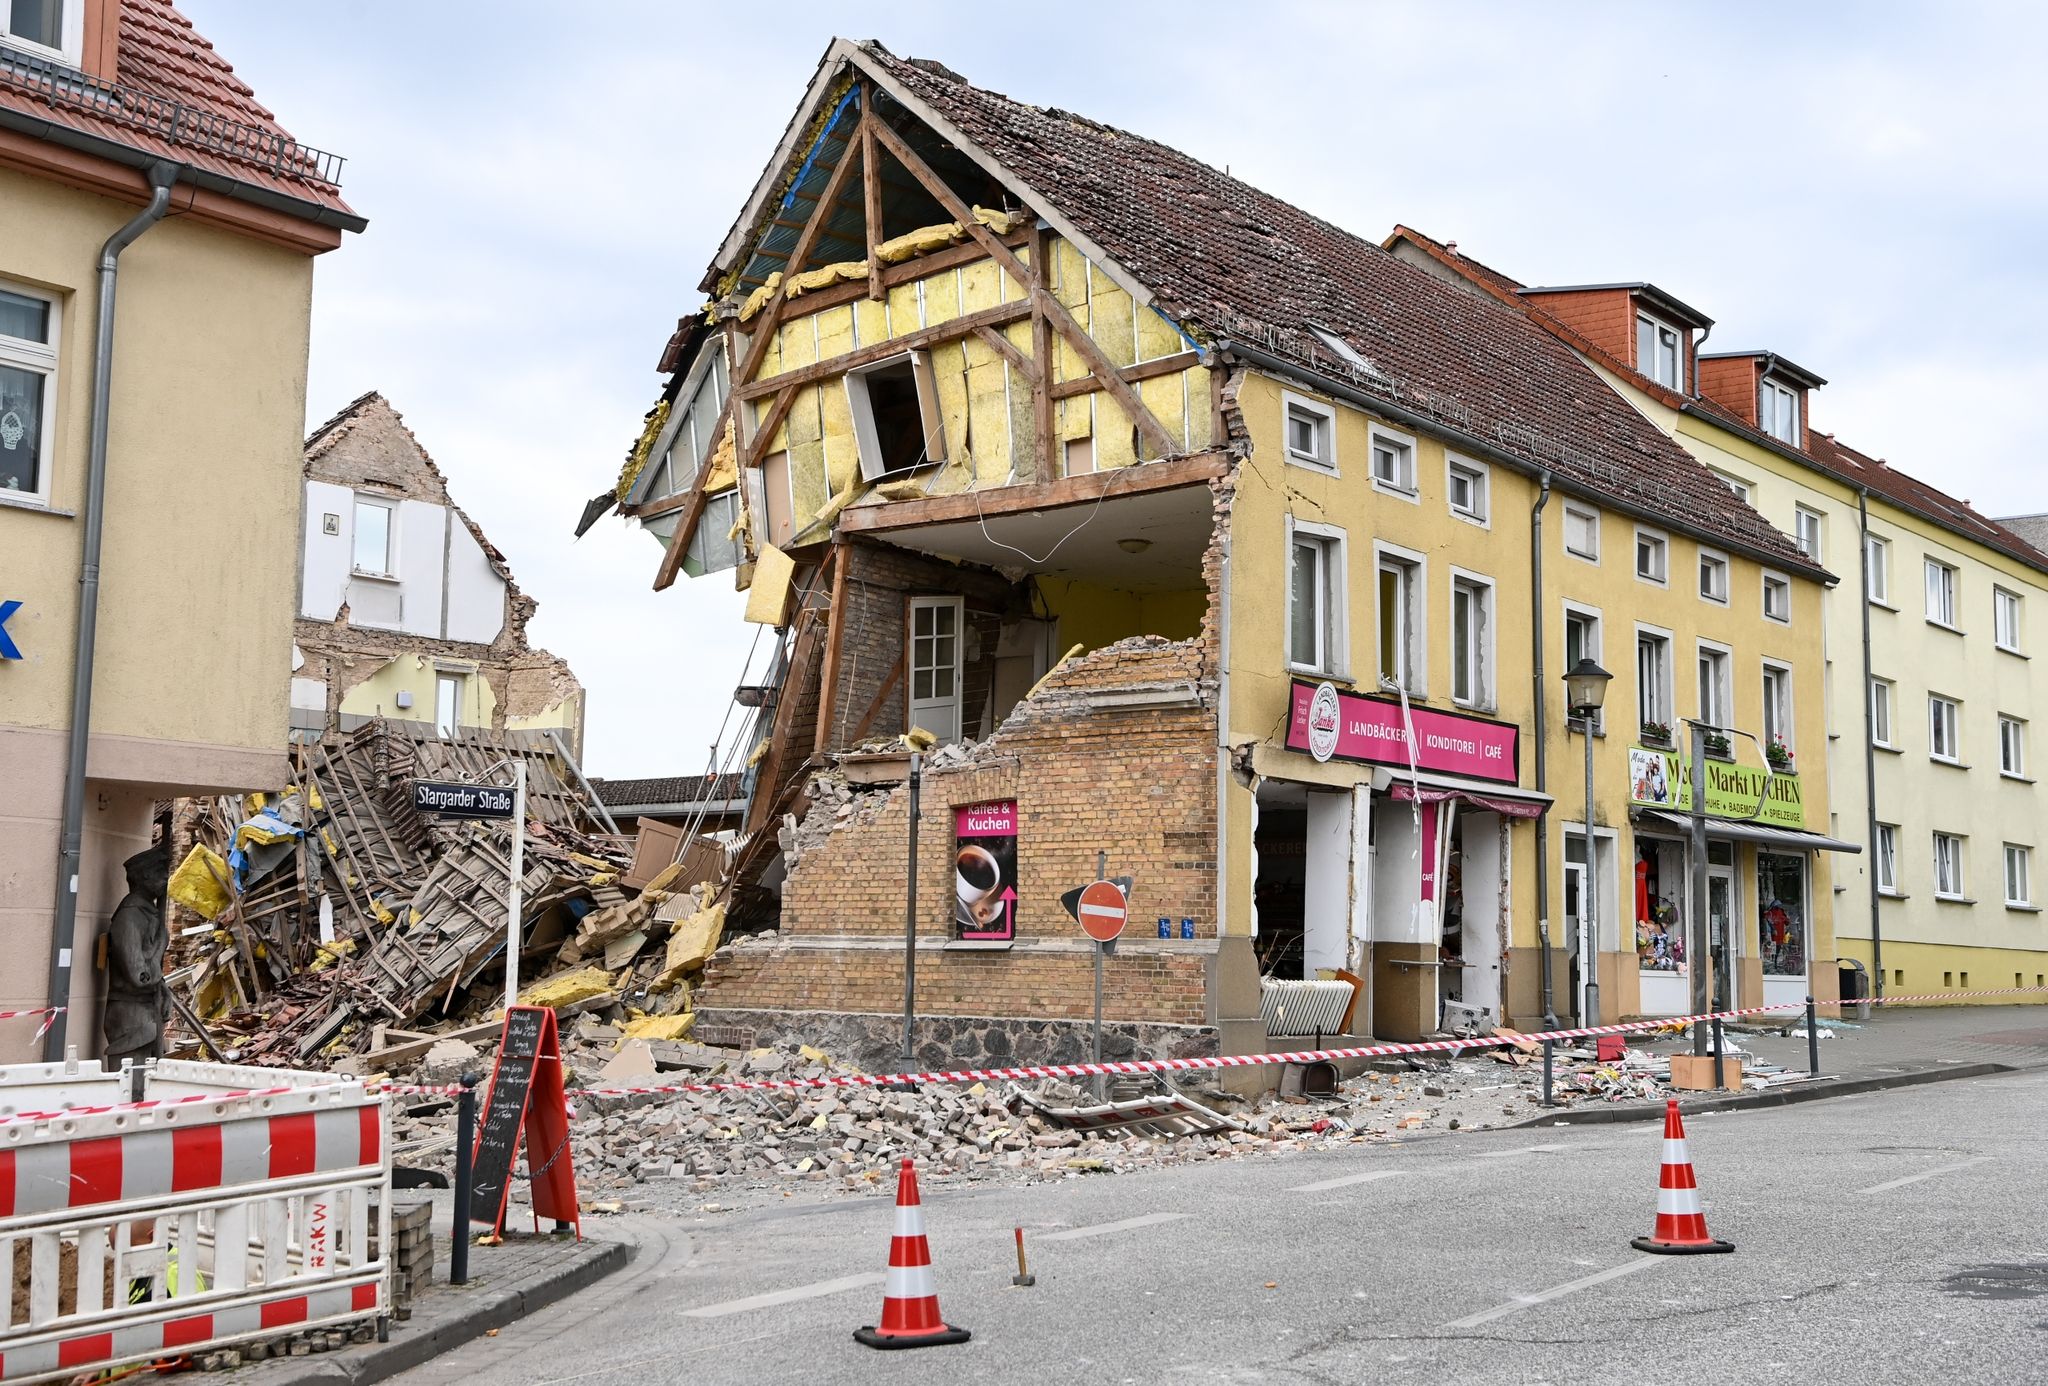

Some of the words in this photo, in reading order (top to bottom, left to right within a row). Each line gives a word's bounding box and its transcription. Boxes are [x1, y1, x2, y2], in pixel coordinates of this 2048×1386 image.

[1349, 721, 1410, 745] LANDBÄCKER
[1426, 734, 1475, 755] KONDITOREI
[1485, 744, 1502, 759] CAFÉ
[1708, 765, 1748, 795] Markt
[1751, 773, 1801, 805] LYCHEN
[418, 786, 476, 809] Stargarder
[479, 791, 511, 811] Straße
[968, 803, 999, 815] Kaffee
[1001, 802, 1010, 814] &
[1728, 802, 1759, 816] BADEMOD
[1769, 808, 1800, 822] SPIELZEUGE
[968, 816, 1010, 831] Kuchen
[1422, 872, 1433, 882] CAFÉ
